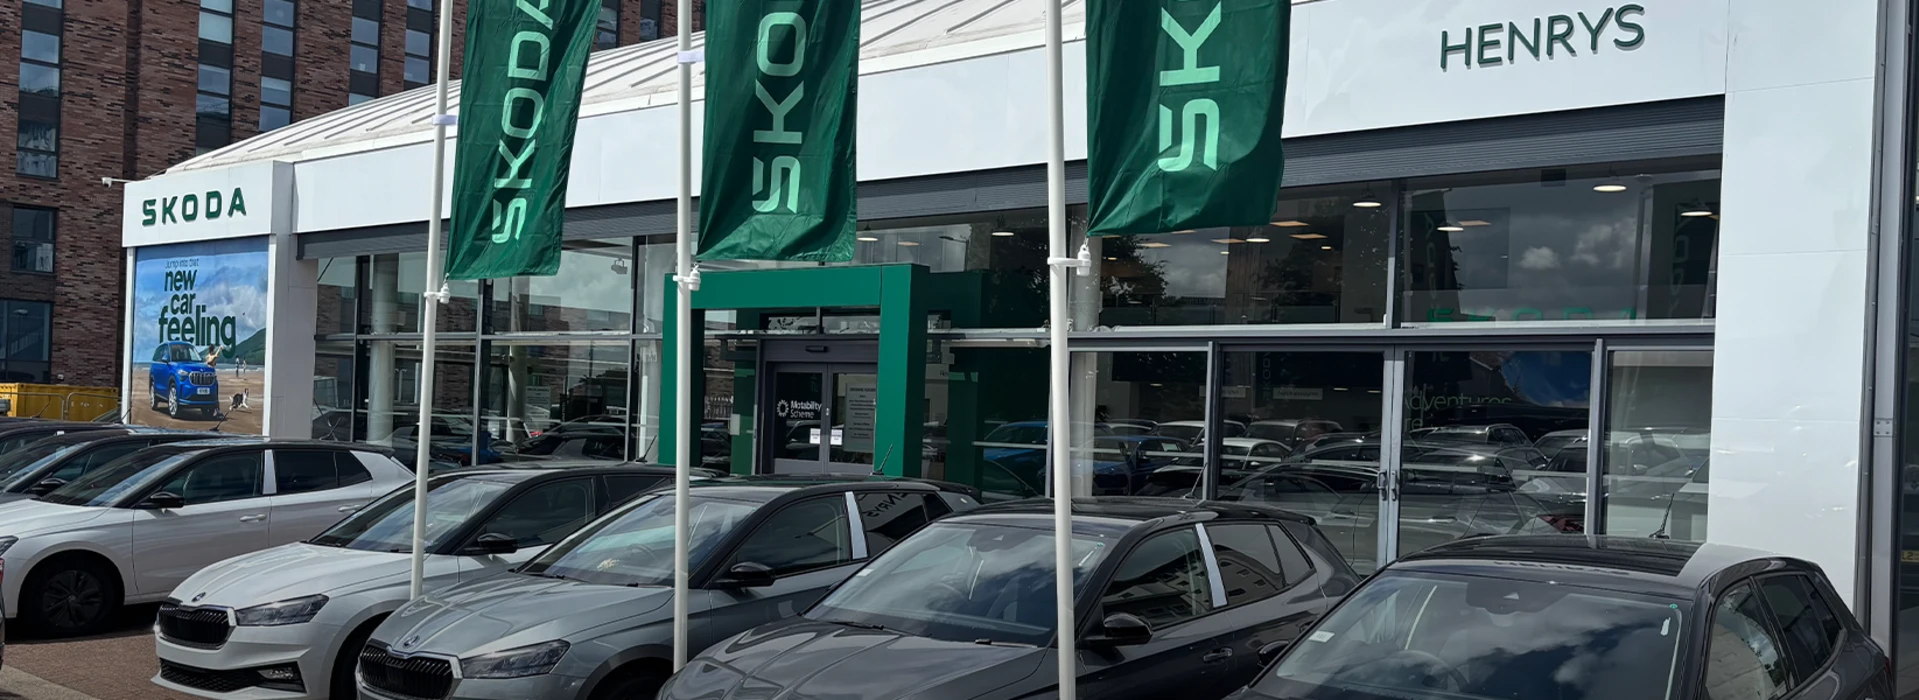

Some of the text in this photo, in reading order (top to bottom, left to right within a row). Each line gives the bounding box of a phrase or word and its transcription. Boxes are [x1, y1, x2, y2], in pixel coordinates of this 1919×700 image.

[1440, 4, 1645, 71] HENRYS
[1157, 0, 1222, 172] SK
[142, 187, 246, 226] SKODA
[164, 269, 198, 292] new
[170, 293, 196, 315] car
[158, 304, 237, 358] feeling
[790, 400, 822, 412] Motability
[790, 410, 815, 419] Scheme
